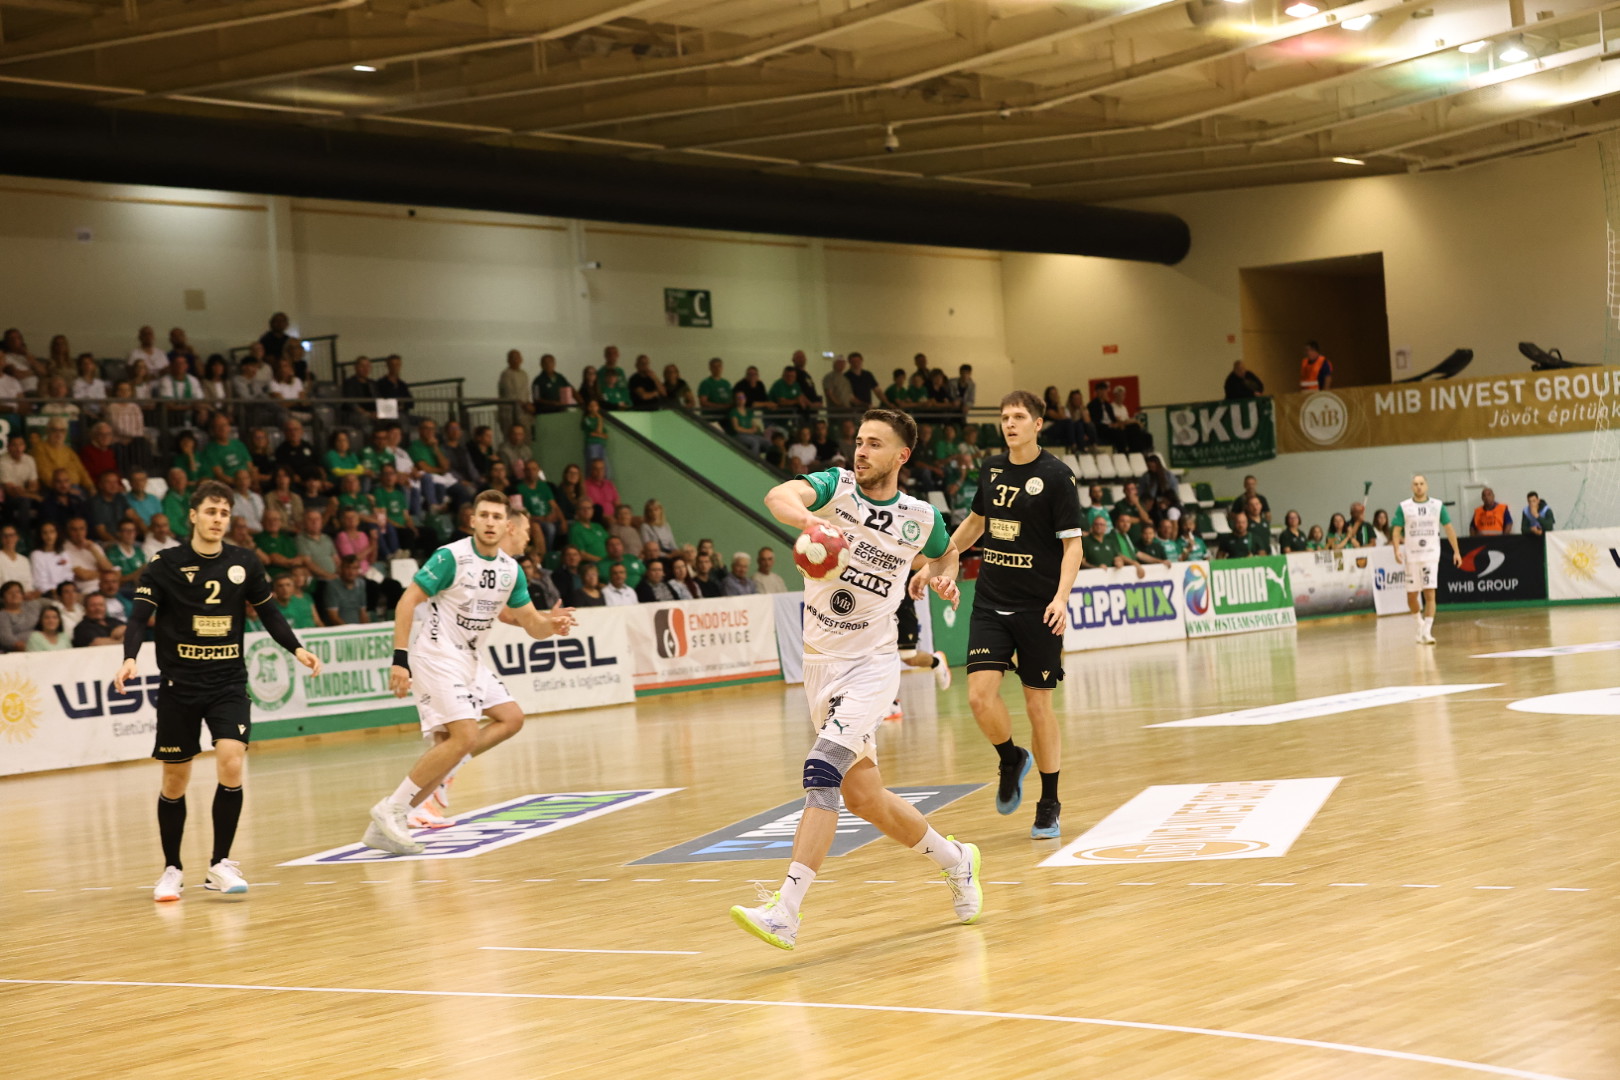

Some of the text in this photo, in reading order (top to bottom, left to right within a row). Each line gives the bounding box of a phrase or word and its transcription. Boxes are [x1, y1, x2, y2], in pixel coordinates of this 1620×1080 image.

[693, 292, 706, 317] C
[1375, 389, 1421, 416] MIB
[1430, 379, 1525, 411] INVEST
[1169, 401, 1259, 446] BKU
[1489, 407, 1539, 428] Jövőt
[993, 484, 1020, 508] 37
[864, 509, 893, 536] 22
[1418, 507, 1427, 516] 19
[854, 548, 897, 570] EGYETEM
[479, 569, 496, 589] 38
[1212, 567, 1268, 607] PUMA
[1447, 578, 1519, 593] WHB GROUP
[205, 580, 221, 604] 2
[817, 613, 839, 628] NVEST
[1187, 612, 1294, 634] WWW.HSTEAMSPORT.HU
[691, 629, 750, 648] SERVICE
[969, 648, 990, 656] MVM
[303, 669, 376, 699] HANDBALL
